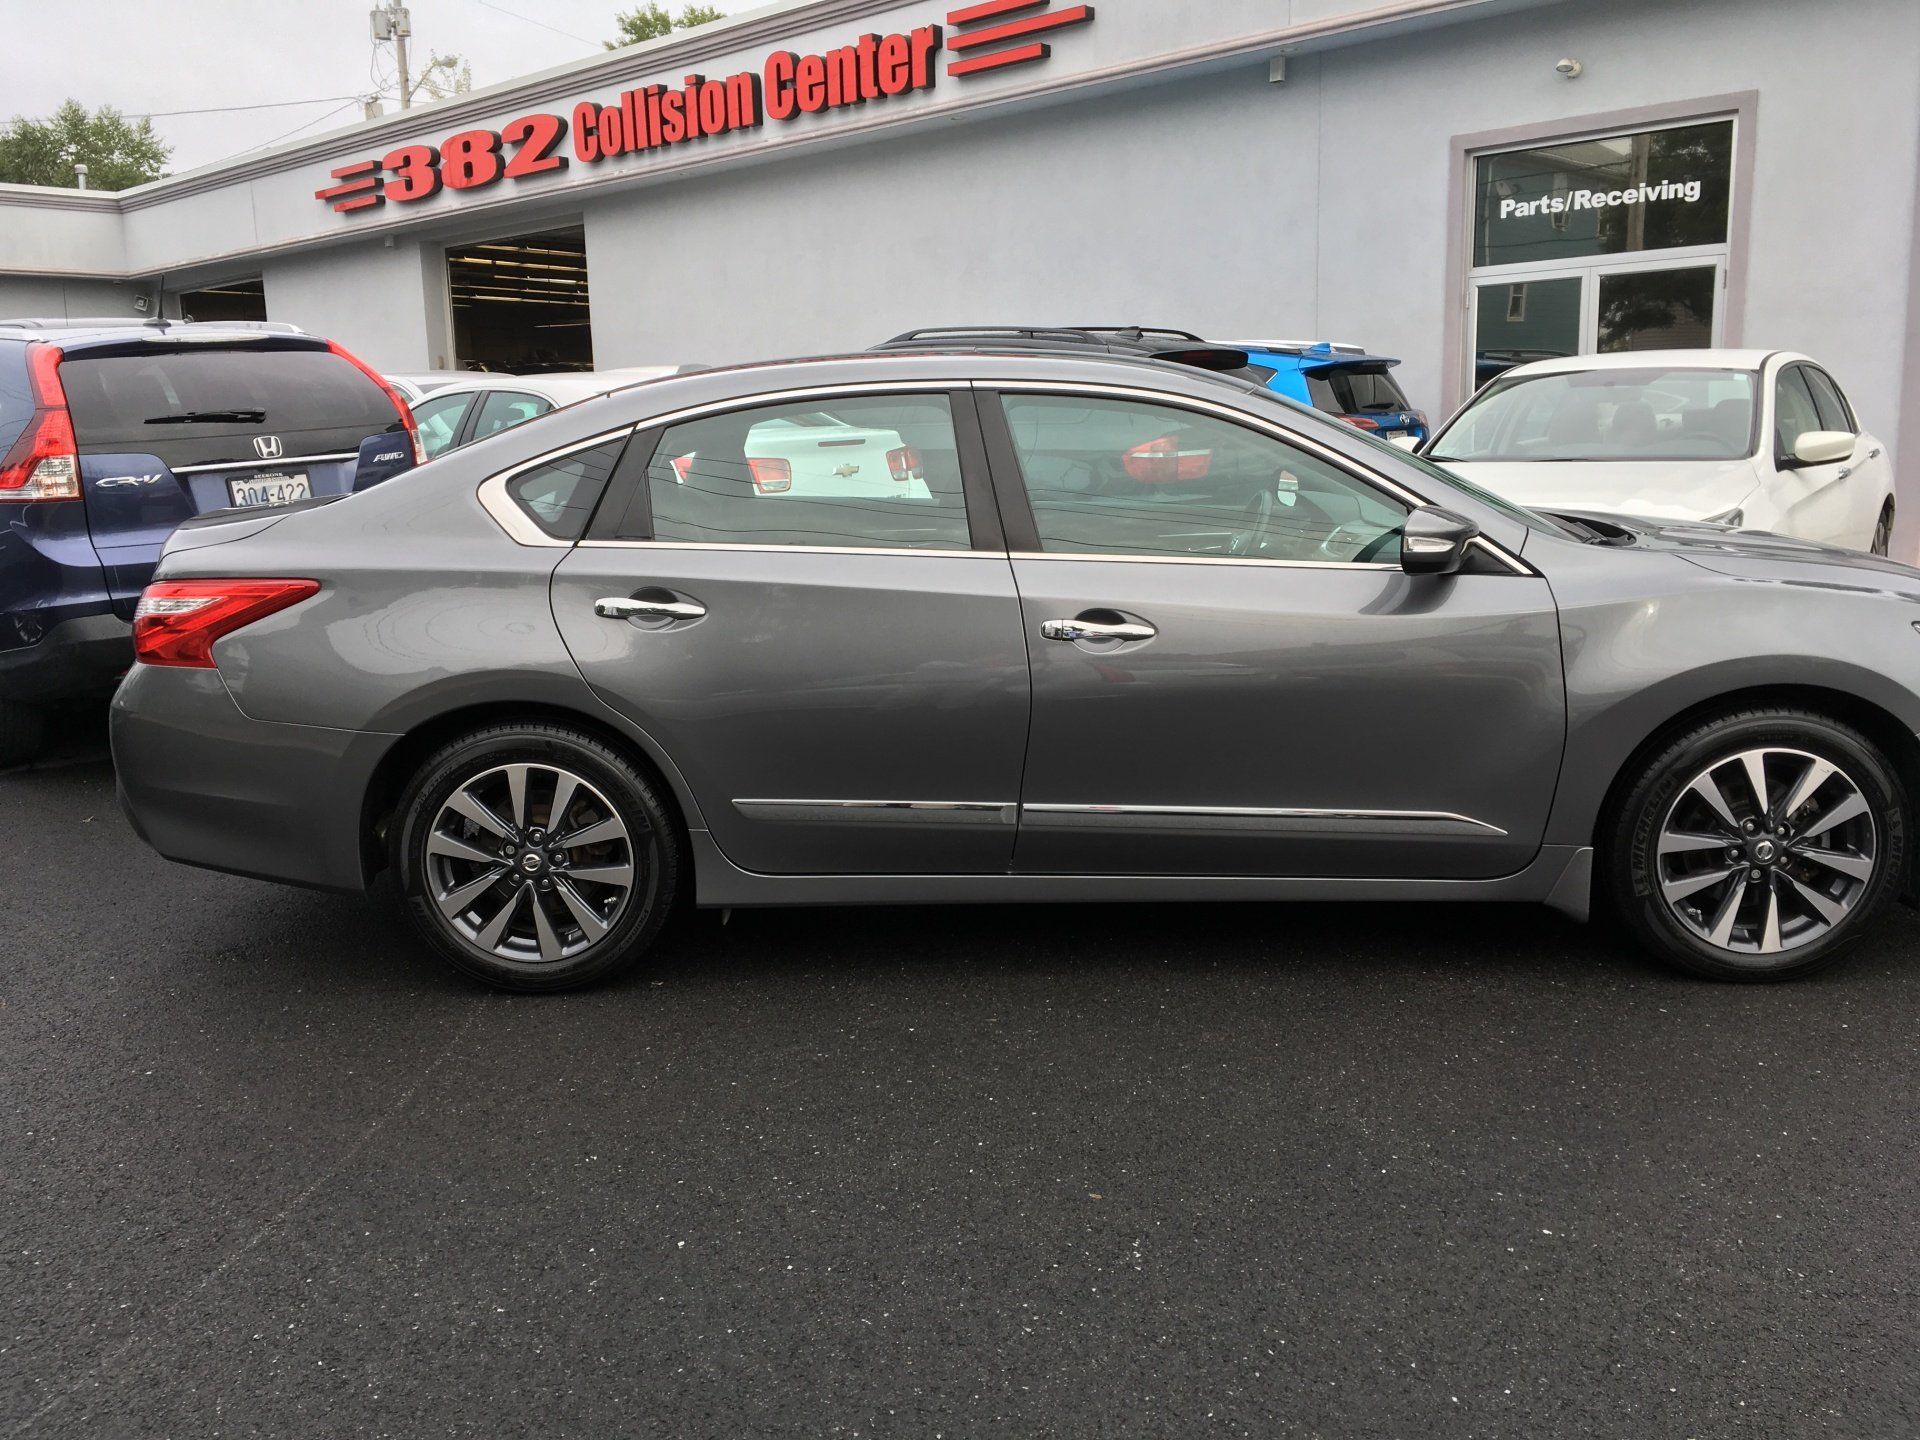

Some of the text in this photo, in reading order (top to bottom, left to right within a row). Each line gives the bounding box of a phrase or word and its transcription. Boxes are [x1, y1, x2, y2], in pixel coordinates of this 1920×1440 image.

[382, 24, 942, 202] 382 Collision Center
[1500, 179, 1701, 220] Parts/Receiving
[372, 451, 405, 463] AWD
[95, 473, 162, 488] CR-V
